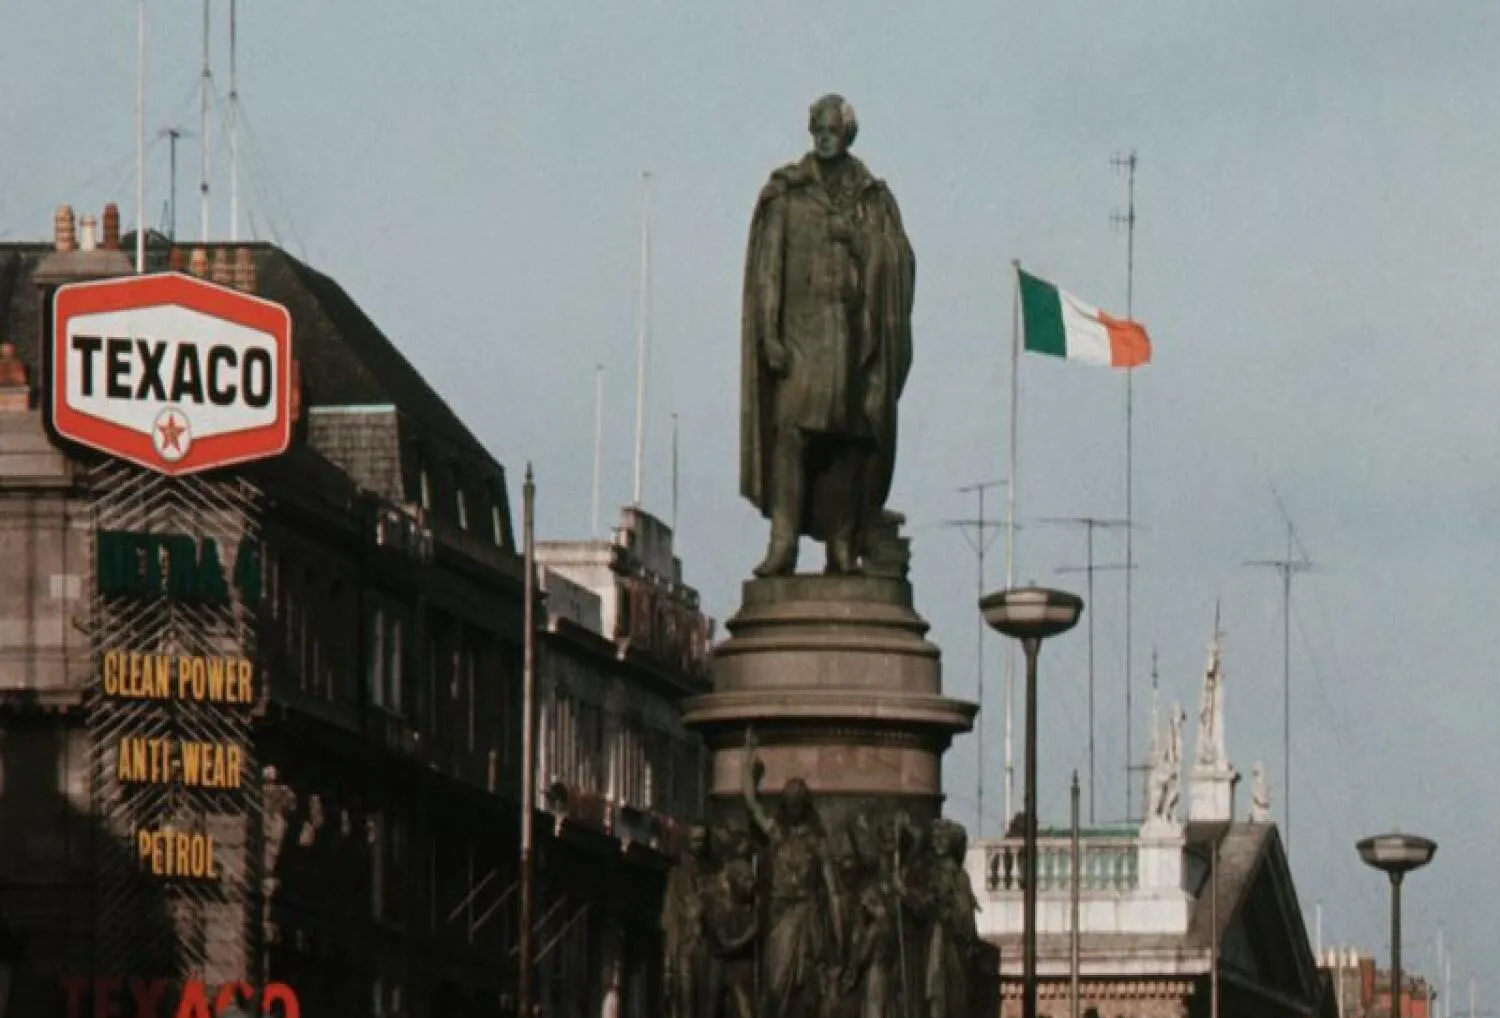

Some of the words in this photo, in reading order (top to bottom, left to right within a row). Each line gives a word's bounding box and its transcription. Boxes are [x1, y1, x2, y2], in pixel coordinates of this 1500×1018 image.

[72, 335, 273, 409] TEXACO
[103, 650, 170, 700] CLEAN
[176, 654, 254, 705] POWER
[118, 736, 242, 790] ANTI-WEAR
[138, 828, 218, 880] PETROL
